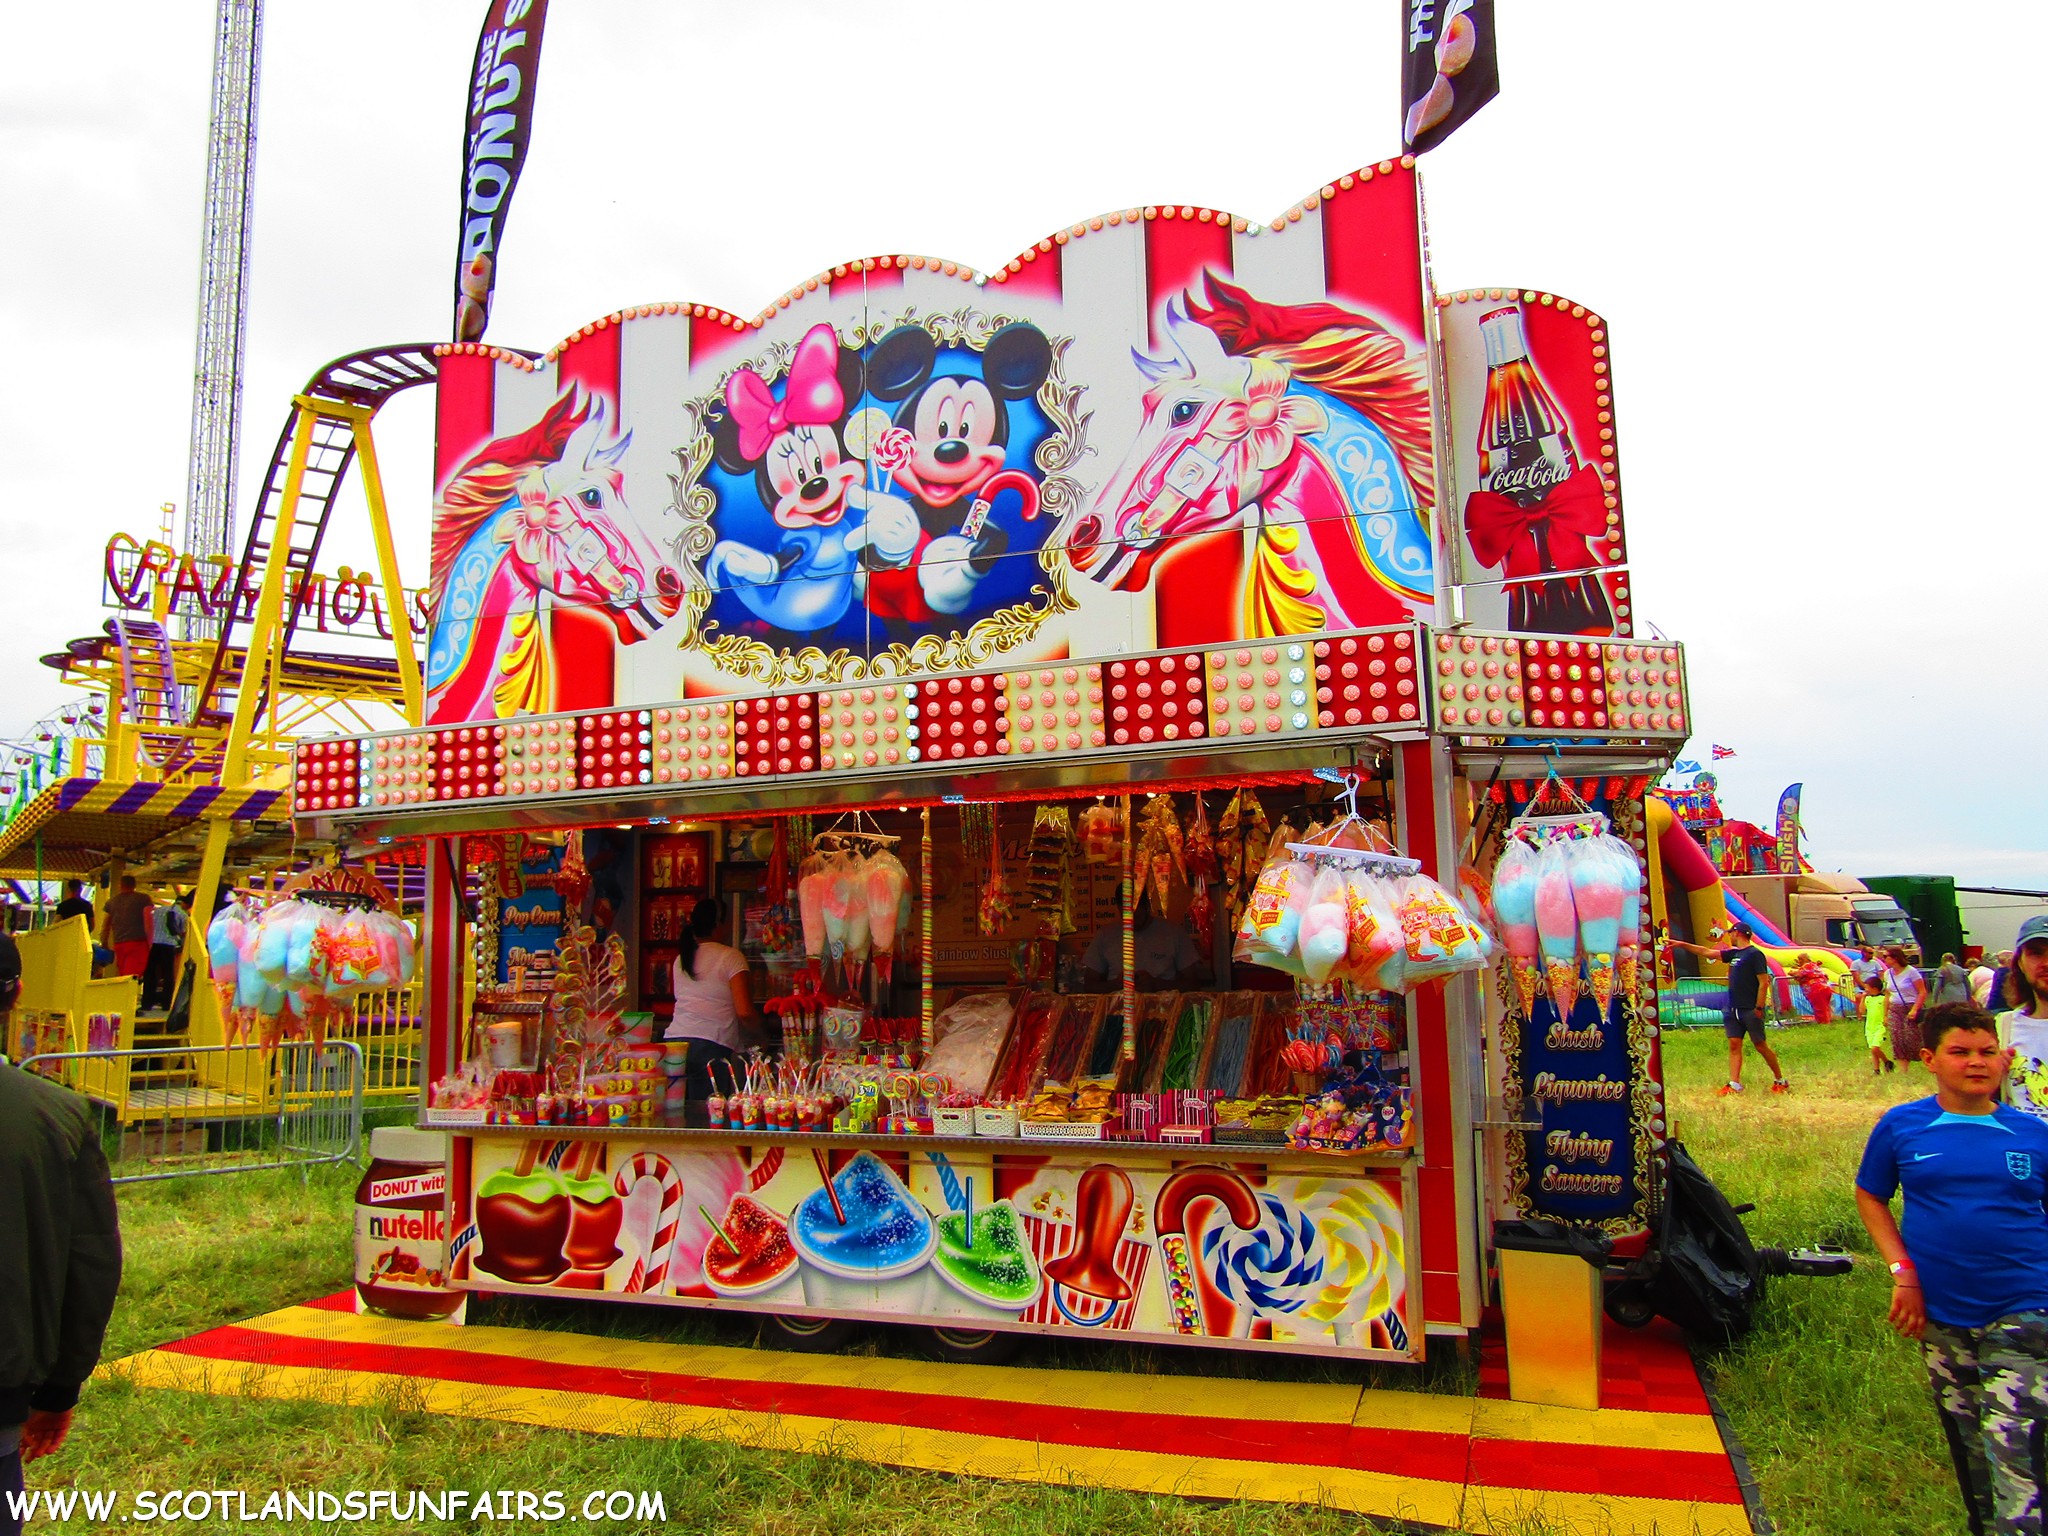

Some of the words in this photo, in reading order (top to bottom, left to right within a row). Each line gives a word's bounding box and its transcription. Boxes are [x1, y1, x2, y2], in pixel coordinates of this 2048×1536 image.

[472, 29, 499, 116] MADE
[463, 0, 533, 262] DONUTS
[1488, 449, 1574, 495] Coca-Cola
[106, 532, 262, 618] CRAZY
[503, 905, 530, 931] Pop
[530, 904, 562, 926] Corn
[932, 946, 978, 960] Rainbow
[1545, 1022, 1604, 1050] Slush
[1184, 1099, 1204, 1109] Candy
[1531, 1071, 1626, 1107] Liquorice
[1545, 1130, 1613, 1163] Flying
[373, 1179, 419, 1198] DONUT
[1540, 1165, 1623, 1194] Saucers
